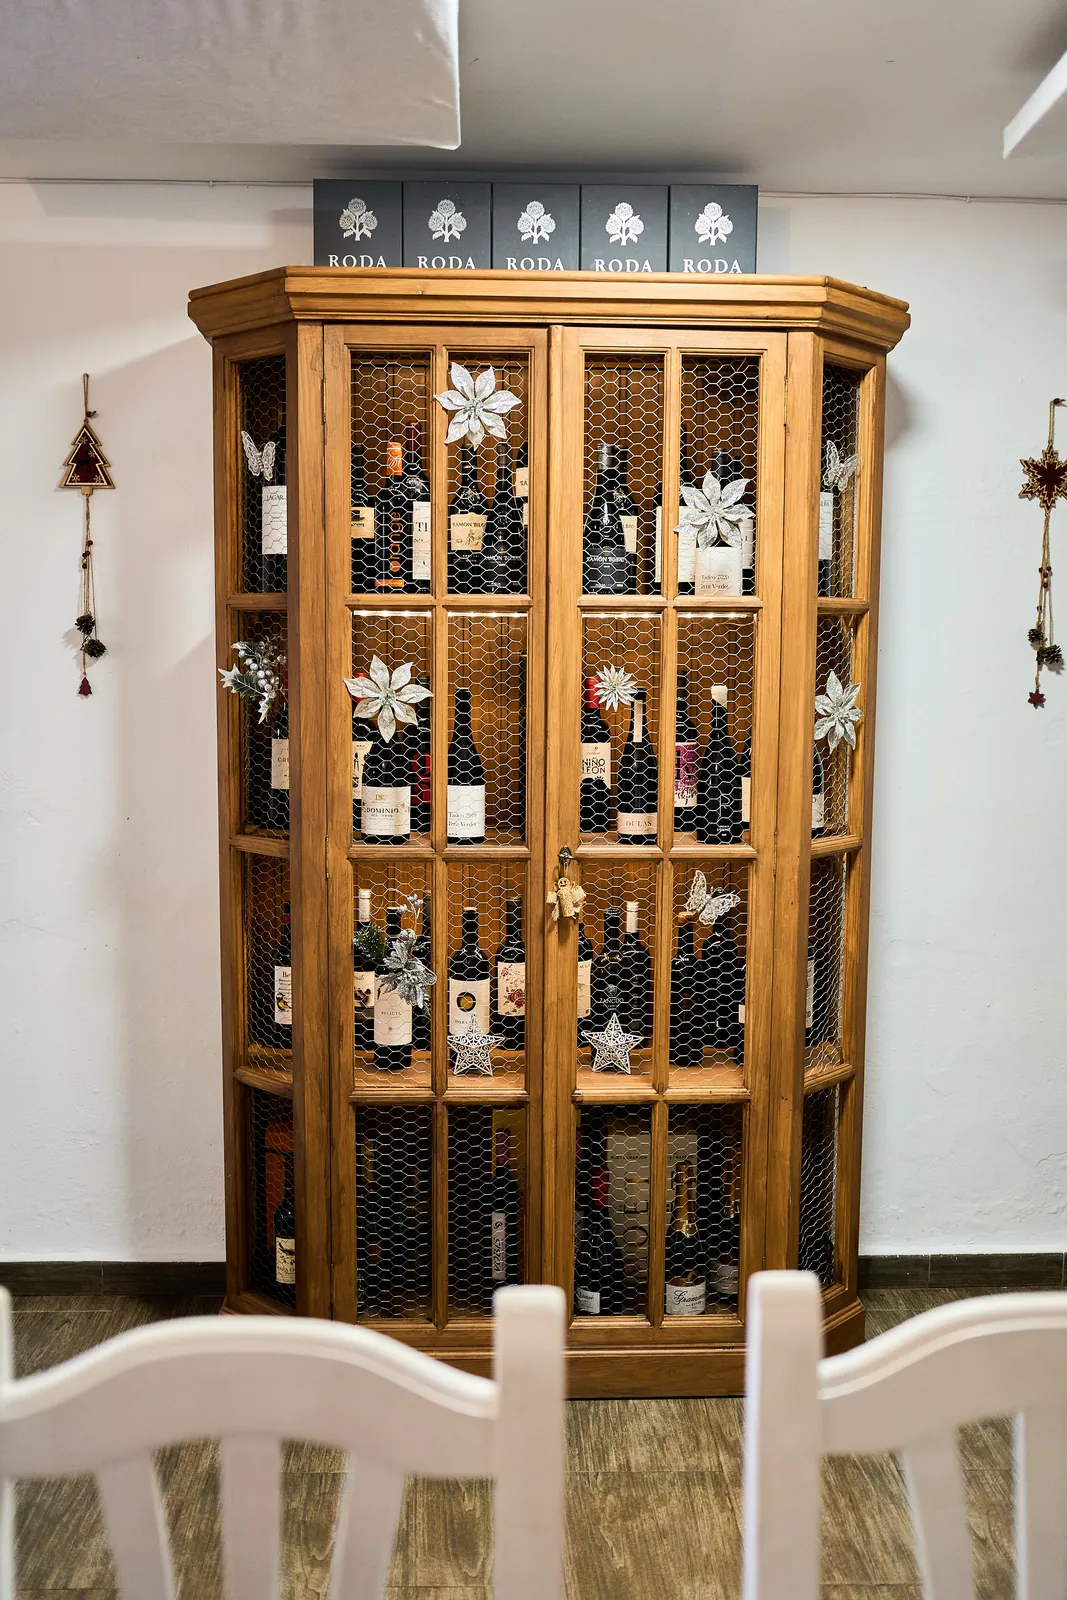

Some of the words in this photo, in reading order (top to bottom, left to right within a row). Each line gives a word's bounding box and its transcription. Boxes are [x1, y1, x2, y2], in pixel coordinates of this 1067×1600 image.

[328, 254, 387, 268] RODA
[417, 255, 476, 269] RODA
[506, 257, 565, 271] RODA
[594, 258, 653, 272] RODA
[682, 258, 742, 273] RODA
[389, 511, 405, 573] orange
